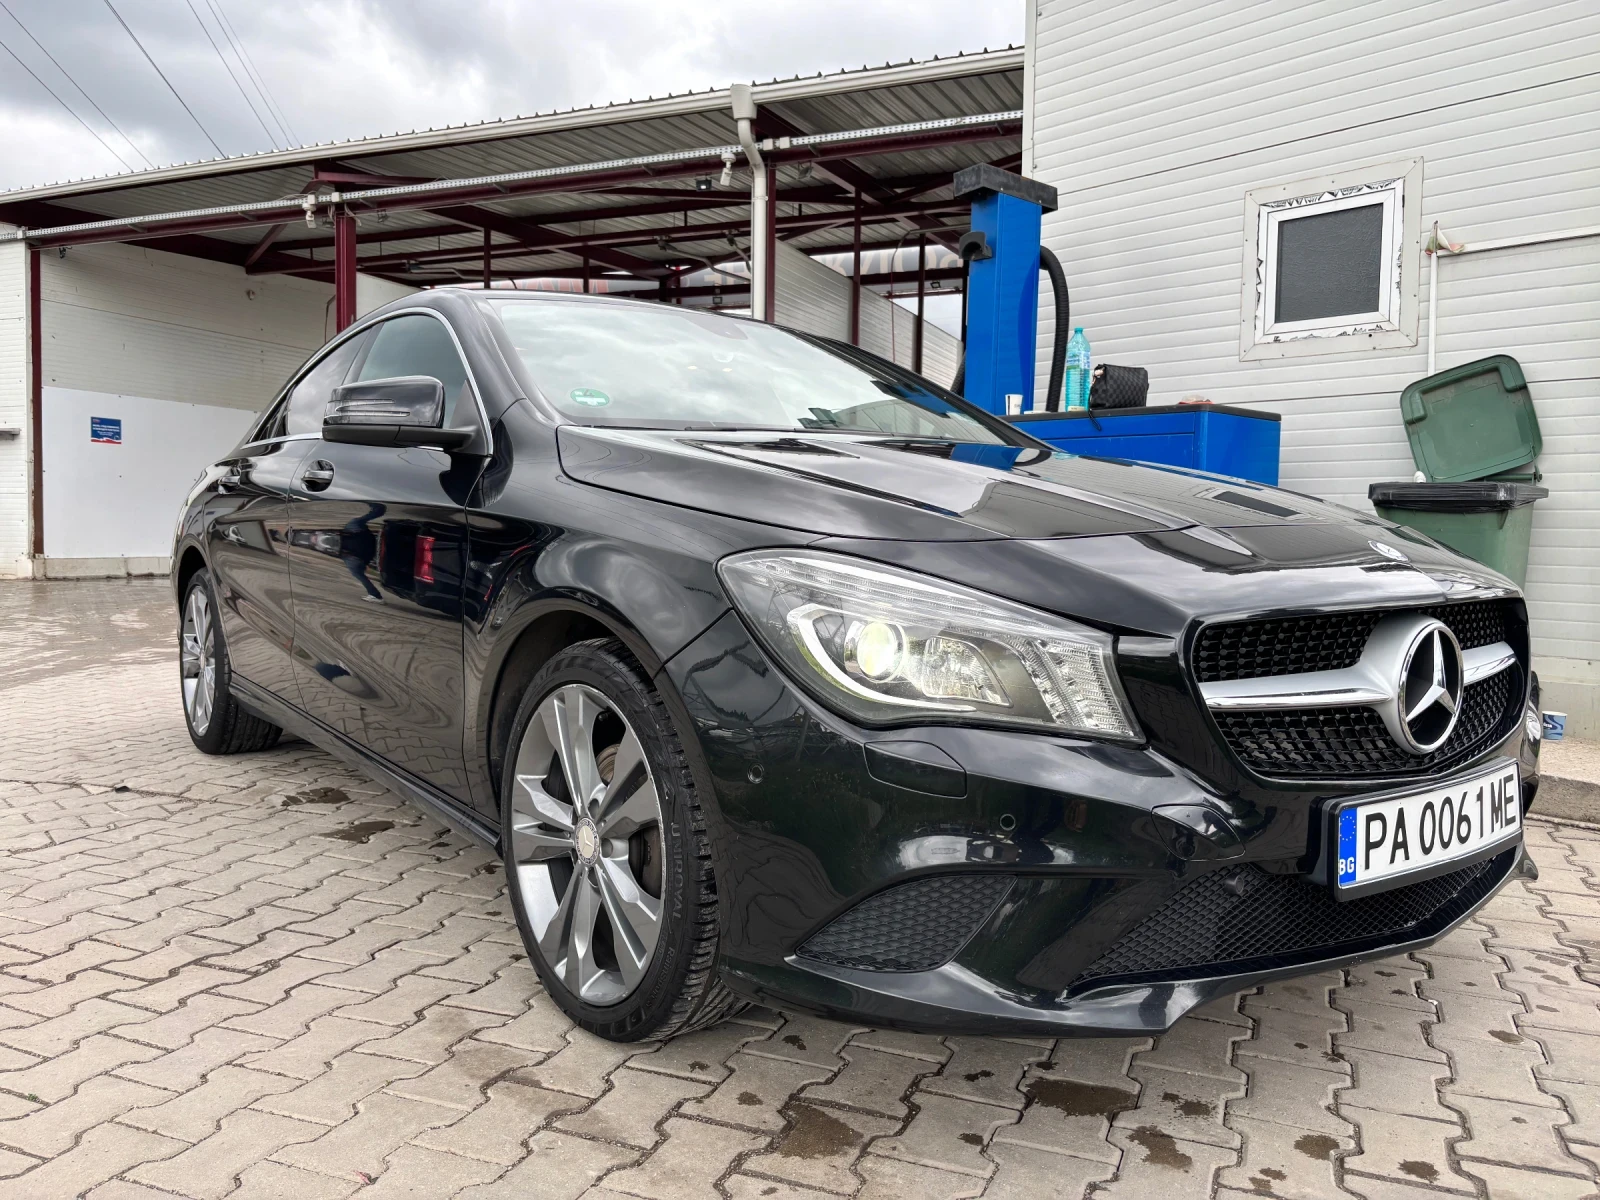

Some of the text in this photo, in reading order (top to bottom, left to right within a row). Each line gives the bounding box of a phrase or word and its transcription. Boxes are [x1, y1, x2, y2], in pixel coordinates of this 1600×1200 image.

[1339, 857, 1355, 875] BG
[1364, 773, 1516, 870] PA 0061 ME
[670, 822, 685, 921] UNIROYAL
